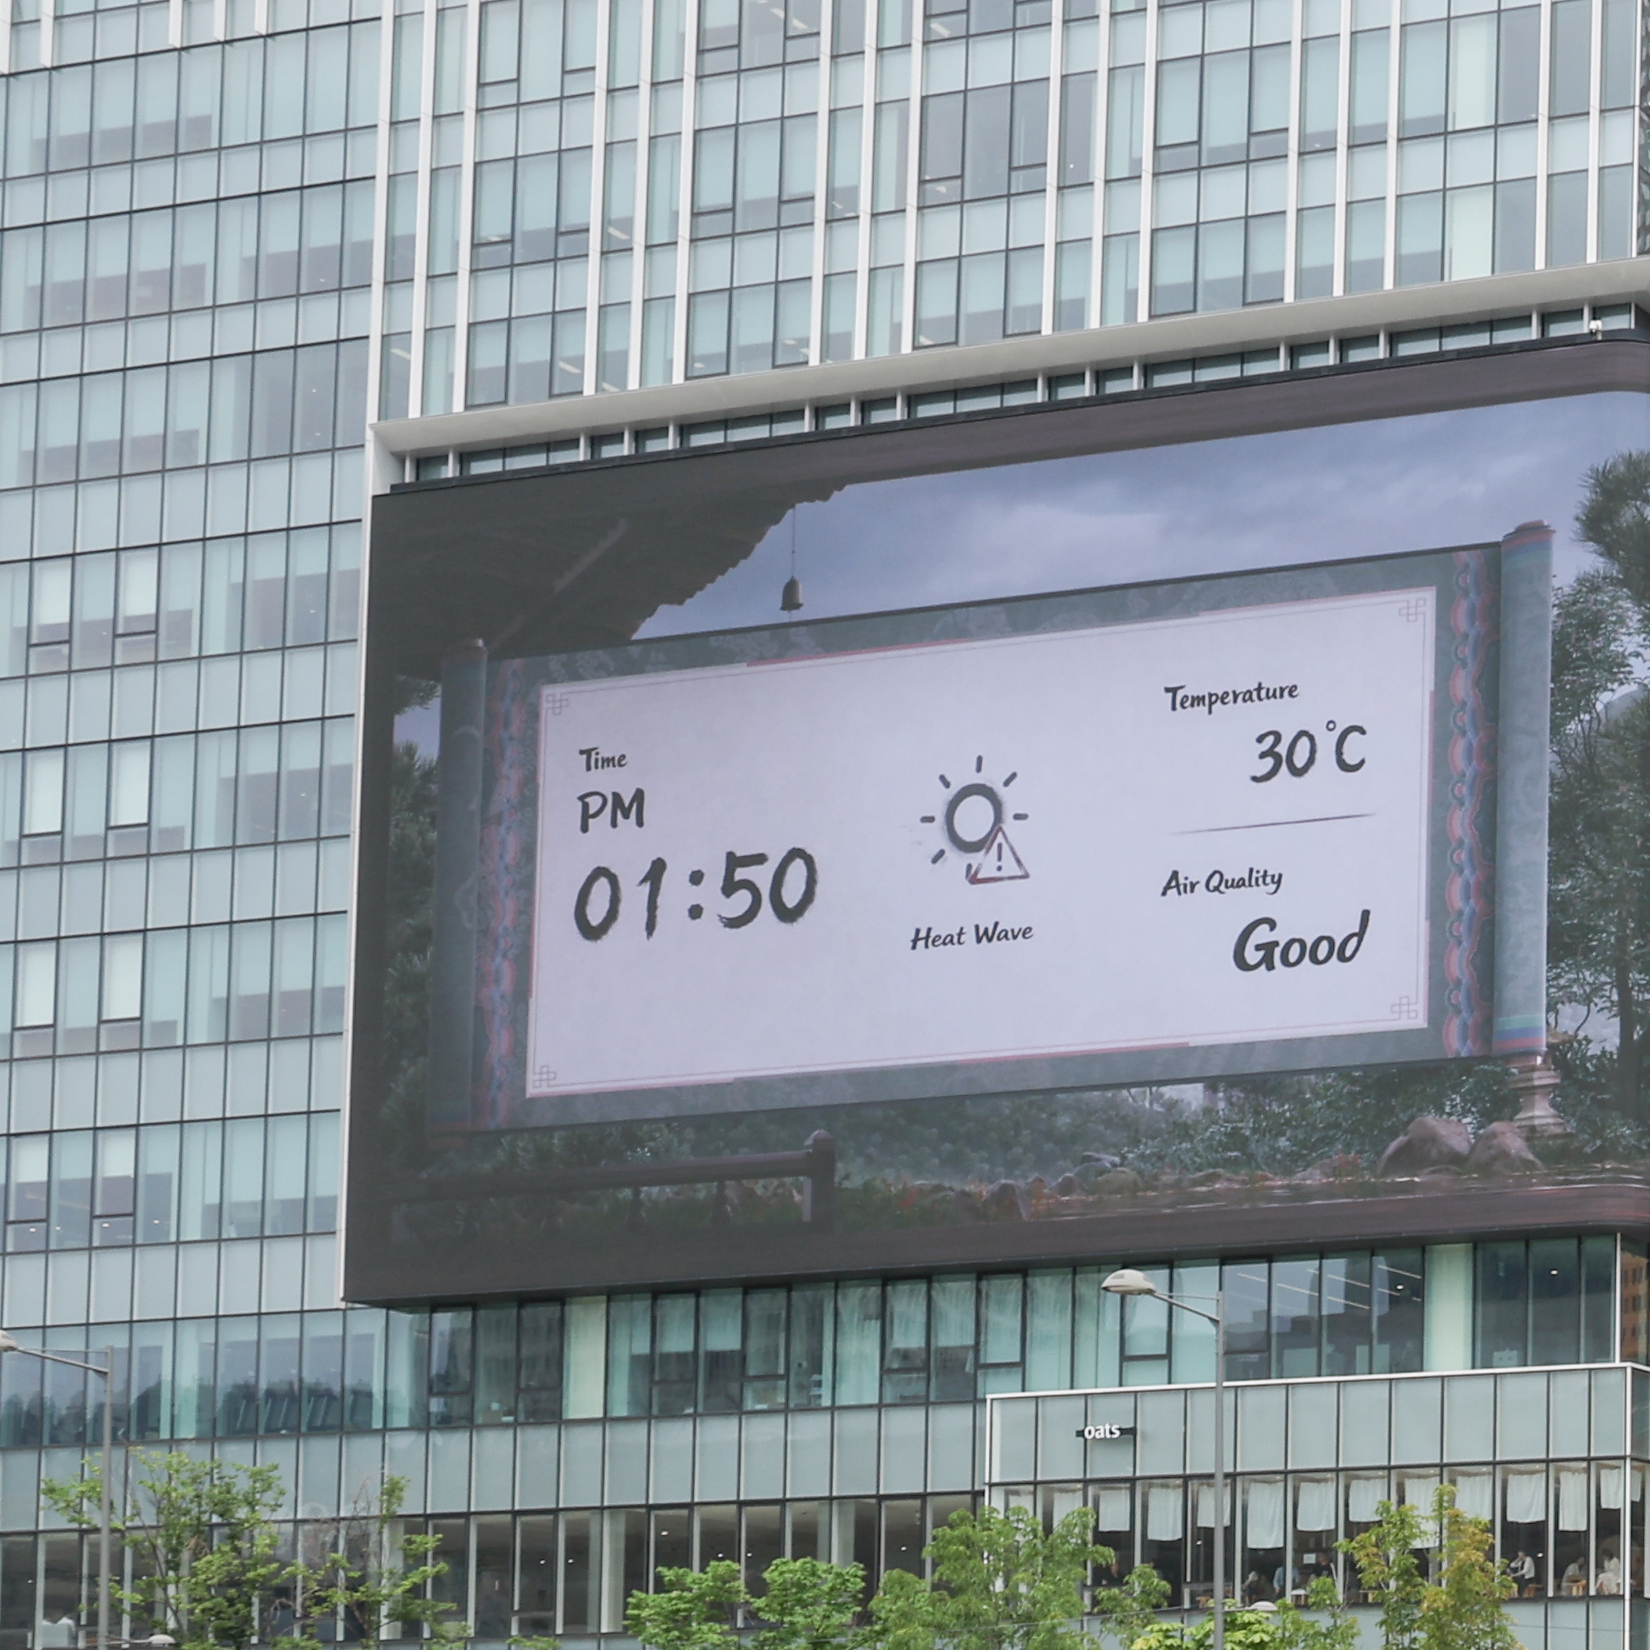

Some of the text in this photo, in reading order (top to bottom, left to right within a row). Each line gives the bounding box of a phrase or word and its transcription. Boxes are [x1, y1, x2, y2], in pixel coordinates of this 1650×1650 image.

[1164, 682, 1299, 715] Temperature
[579, 747, 628, 772] Time
[1250, 720, 1367, 783] 30°C
[577, 788, 645, 833] PM
[574, 847, 817, 942] 01:50
[1161, 868, 1283, 896] Air Quality
[911, 921, 1034, 950] Heat Wave
[1233, 909, 1371, 972] Good
[1084, 1422, 1121, 1440] oats
